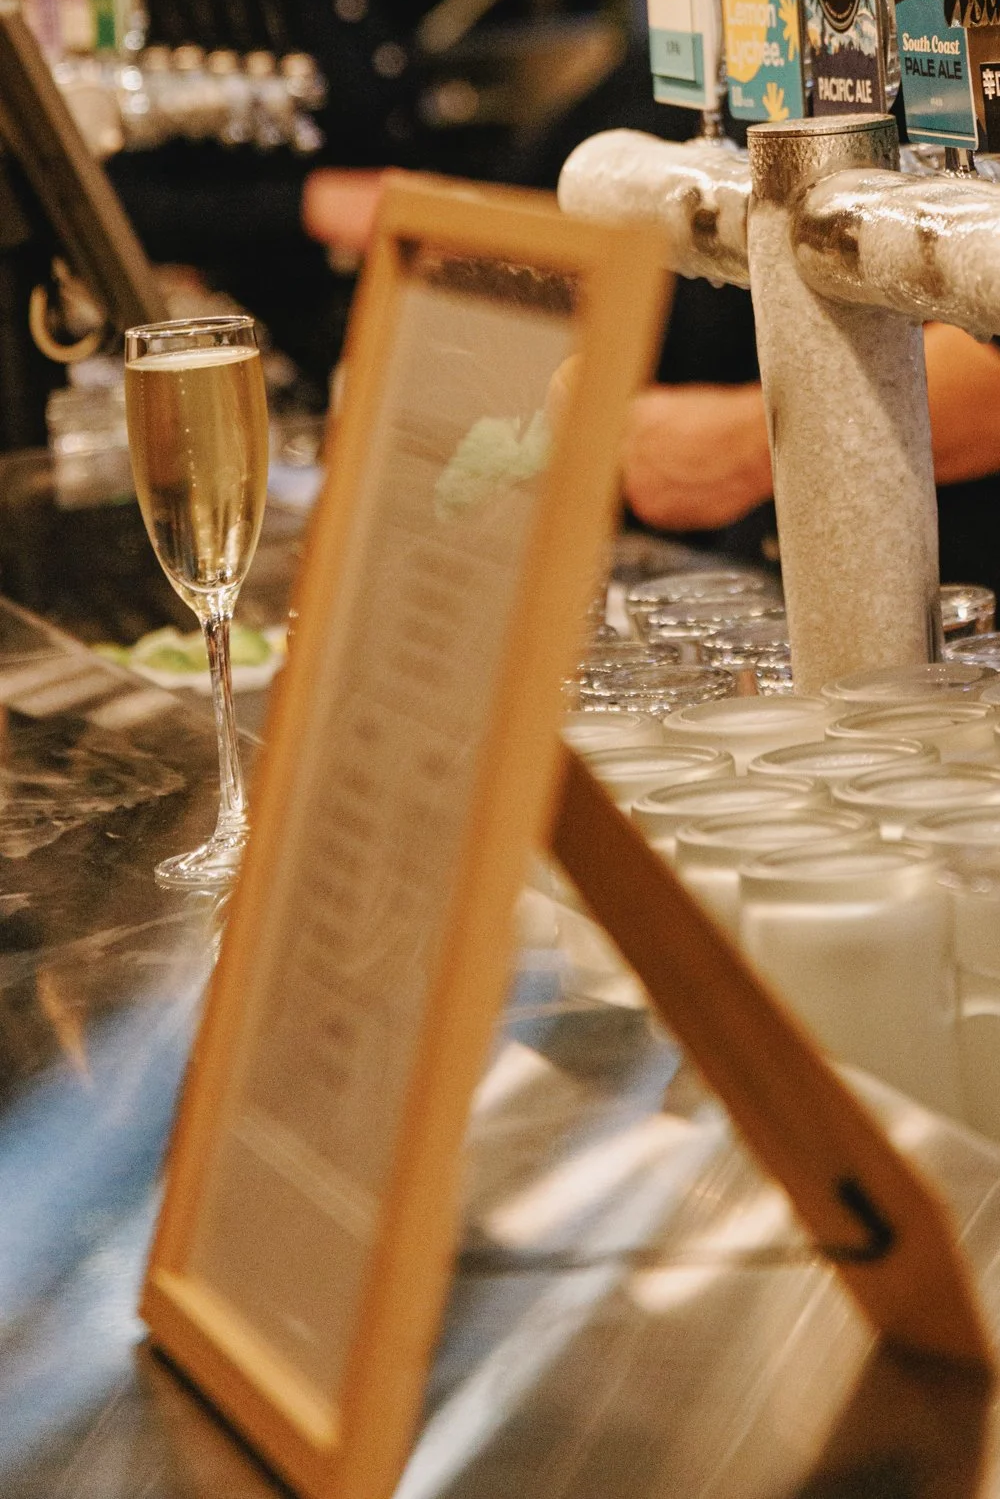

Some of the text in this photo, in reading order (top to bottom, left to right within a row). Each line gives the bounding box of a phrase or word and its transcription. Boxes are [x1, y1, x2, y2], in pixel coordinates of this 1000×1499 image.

[902, 32, 961, 55] South Coast
[904, 56, 962, 80] PALE ALE
[818, 76, 873, 104] PACIFIC ALE
